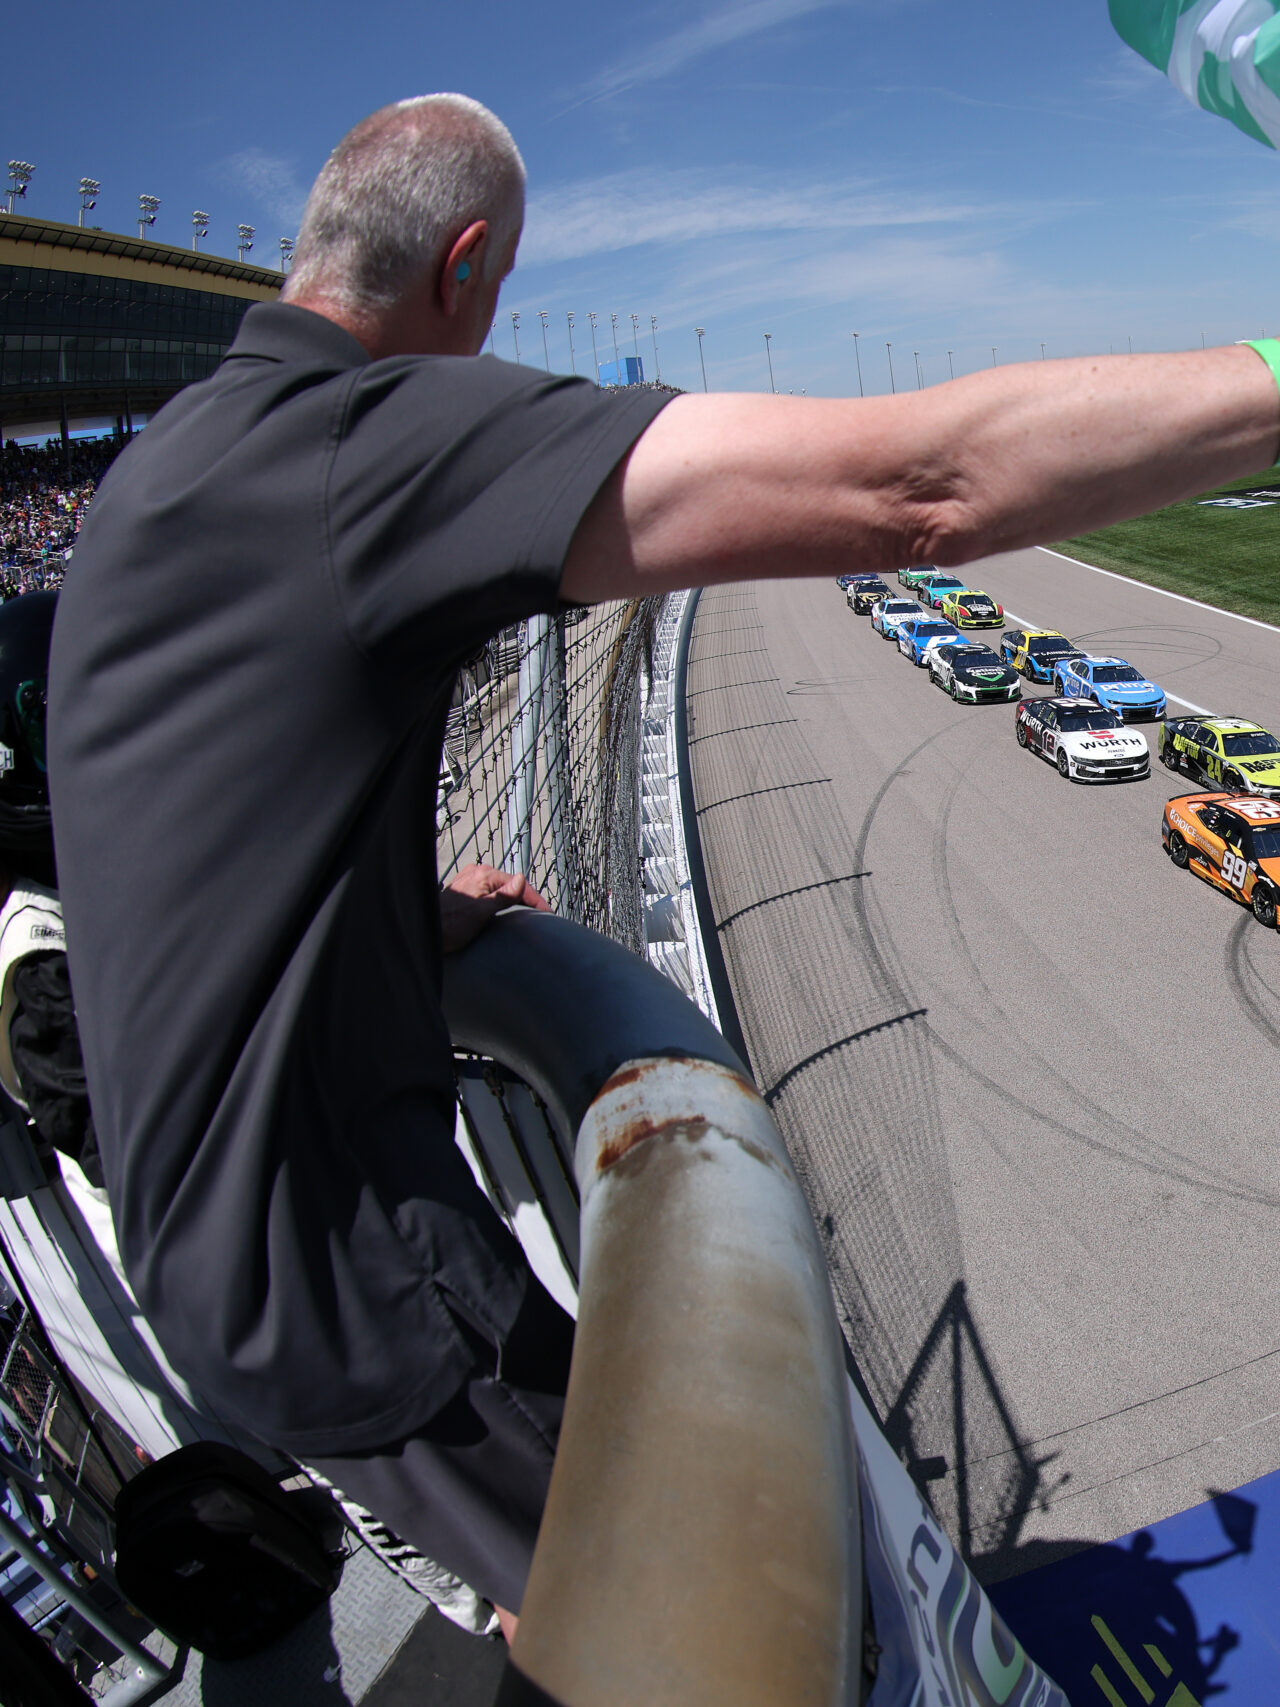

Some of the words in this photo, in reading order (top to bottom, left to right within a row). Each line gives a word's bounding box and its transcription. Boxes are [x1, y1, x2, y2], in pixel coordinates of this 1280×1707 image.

[1099, 681, 1154, 692] prime
[1042, 730, 1056, 756] 12
[1206, 755, 1223, 784] 24
[1220, 849, 1248, 890] 99
